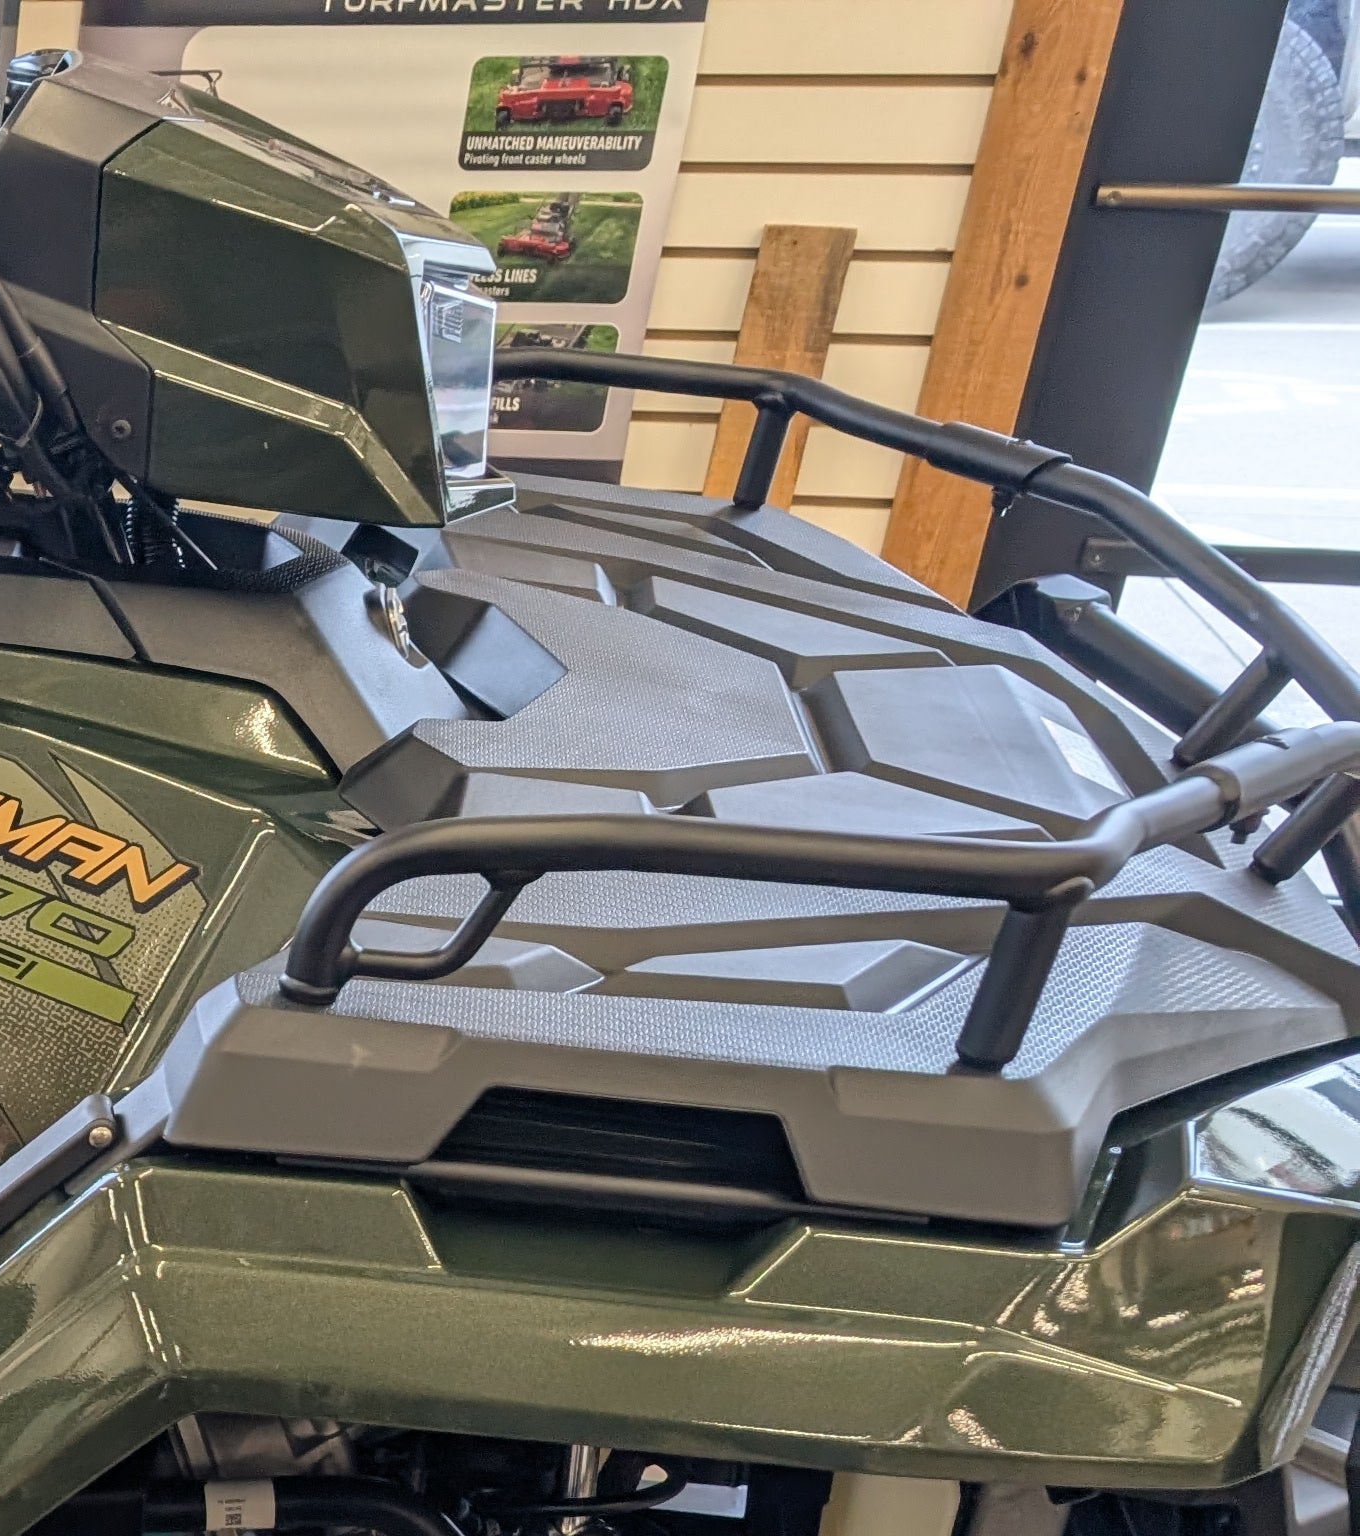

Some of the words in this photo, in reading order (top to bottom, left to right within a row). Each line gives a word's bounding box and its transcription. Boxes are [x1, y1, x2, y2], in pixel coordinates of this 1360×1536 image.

[466, 135, 534, 151] UNMATCHED
[536, 135, 643, 151] MANEUVERABILITY
[464, 152, 499, 167] Pivoting
[501, 152, 524, 165] front
[525, 153, 553, 166] caster
[554, 152, 587, 166] wheels
[505, 268, 538, 284] LINES
